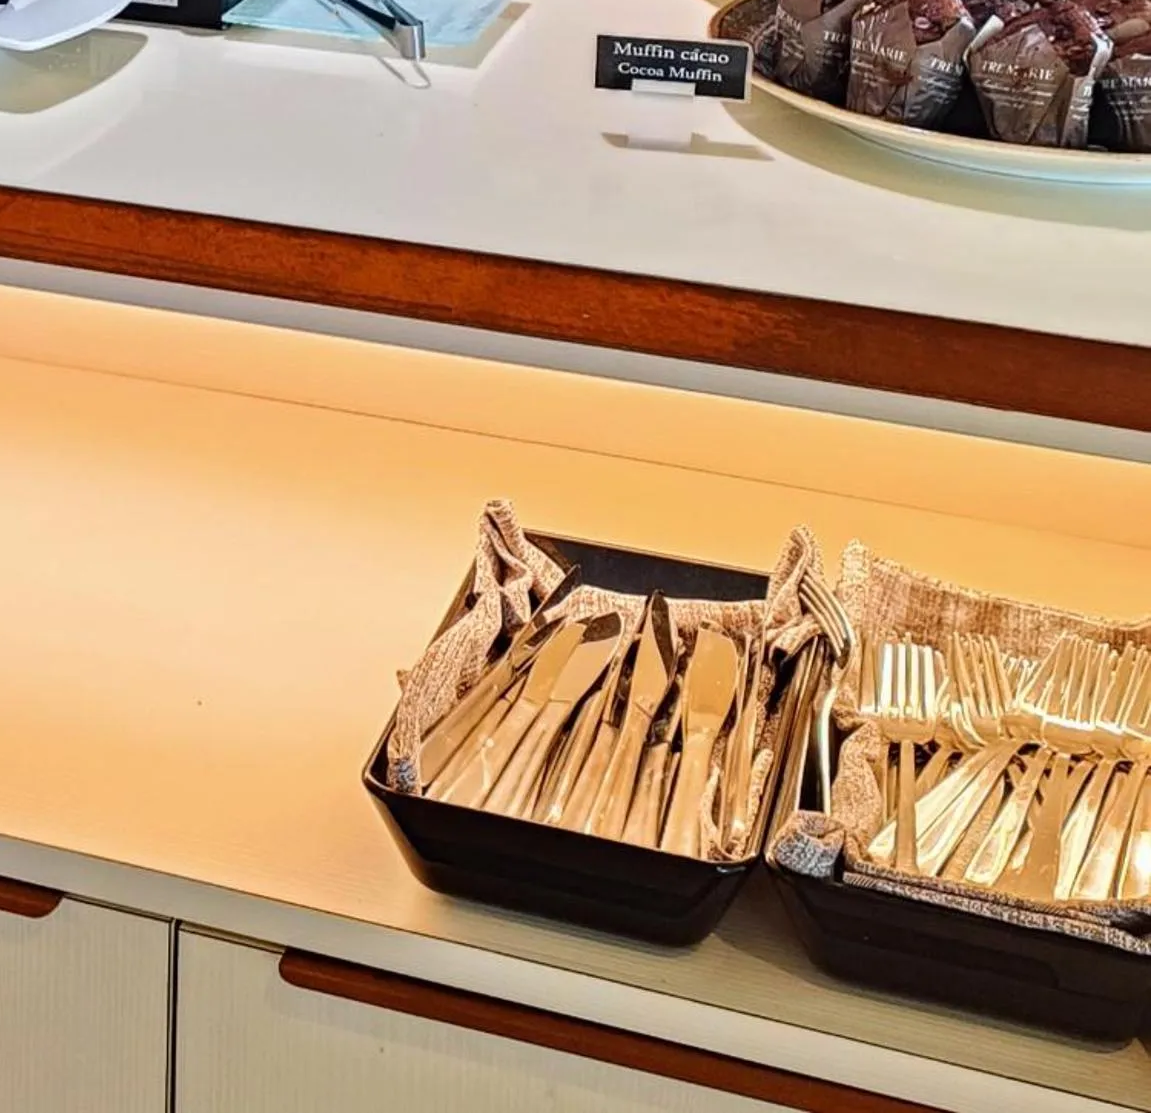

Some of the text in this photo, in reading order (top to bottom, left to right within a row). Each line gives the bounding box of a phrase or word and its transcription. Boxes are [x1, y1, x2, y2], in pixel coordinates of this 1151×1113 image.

[613, 41, 675, 60] Muffin
[617, 61, 722, 82] Cocoa Muffin
